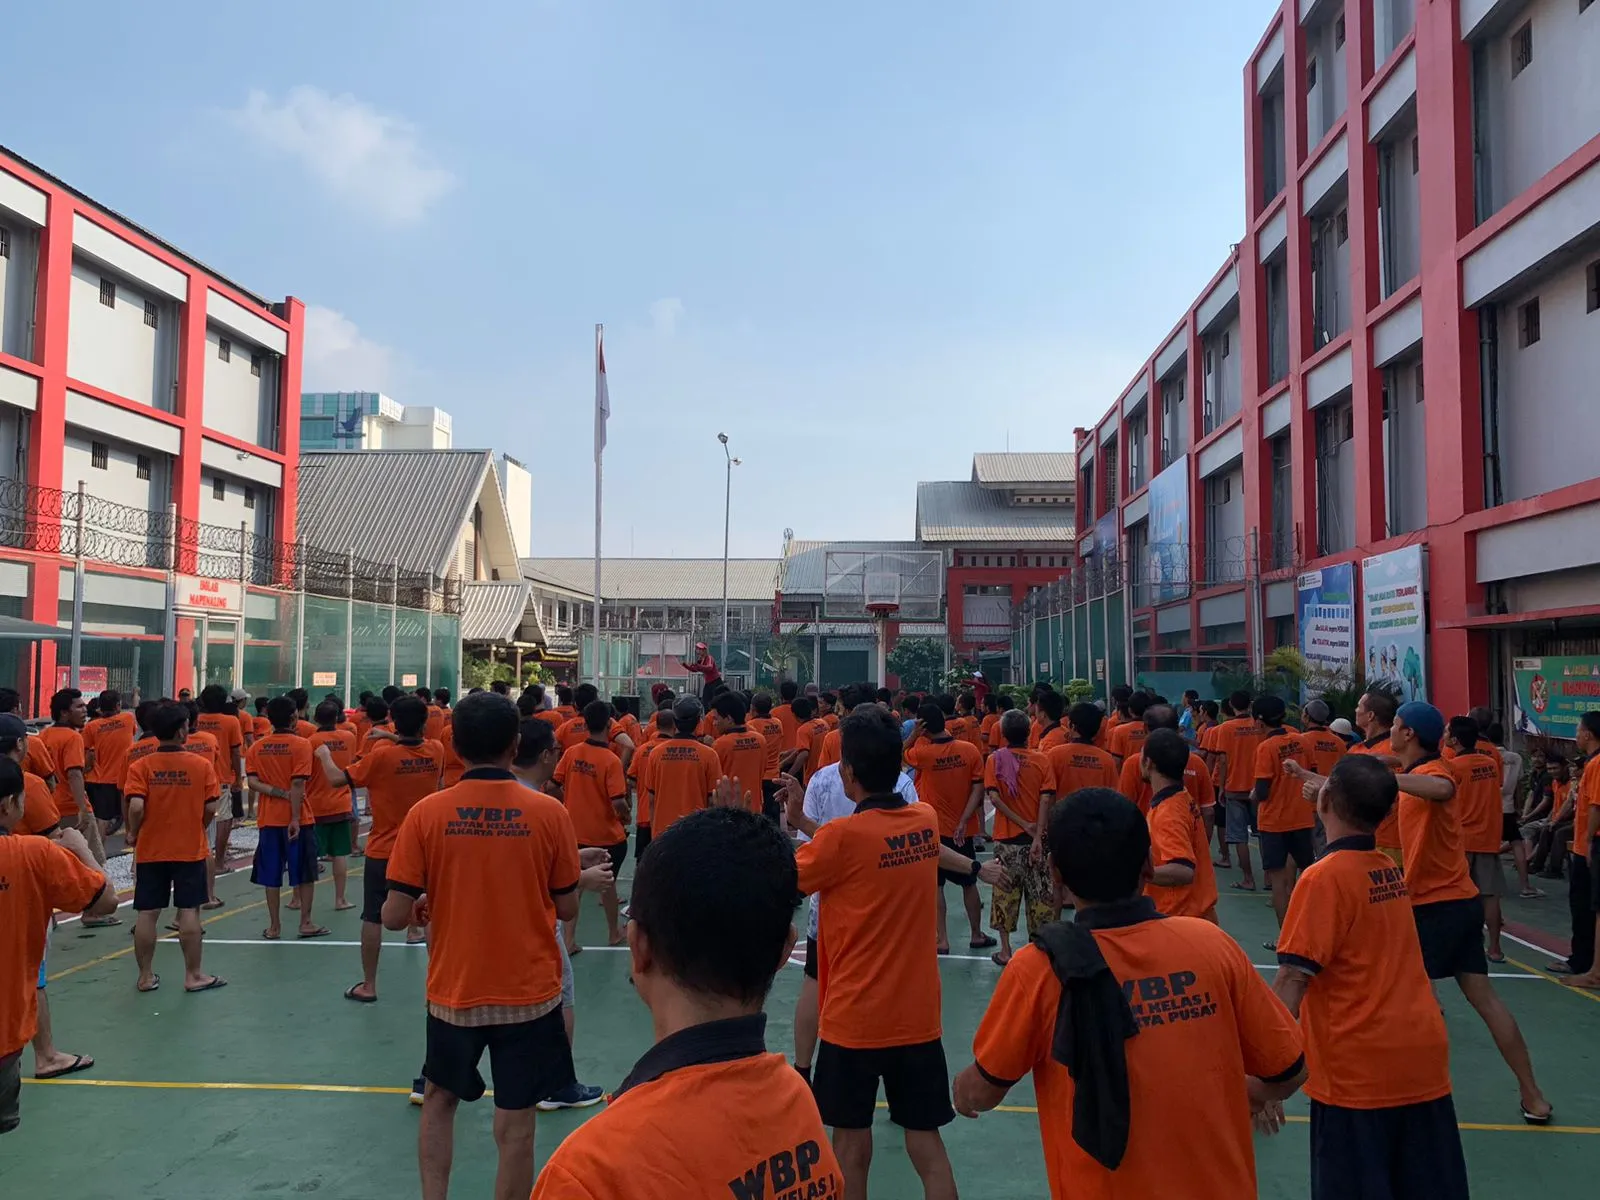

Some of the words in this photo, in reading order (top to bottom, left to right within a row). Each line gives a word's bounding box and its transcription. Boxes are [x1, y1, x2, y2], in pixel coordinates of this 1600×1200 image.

[400, 758, 432, 766] WBP
[456, 807, 522, 821] WBP
[445, 828, 493, 836] JAKARTA
[497, 829, 532, 837] PUSAT
[448, 821, 483, 829] RUTAN
[487, 822, 520, 830] KELAS
[884, 828, 934, 850] WBP
[880, 849, 911, 861] RUTAN
[913, 844, 936, 854] KELAS
[878, 855, 921, 869] JAKARTA
[1148, 994, 1202, 1013] KELAS
[1168, 1003, 1217, 1023] PUSAT
[728, 1140, 821, 1200] WBP
